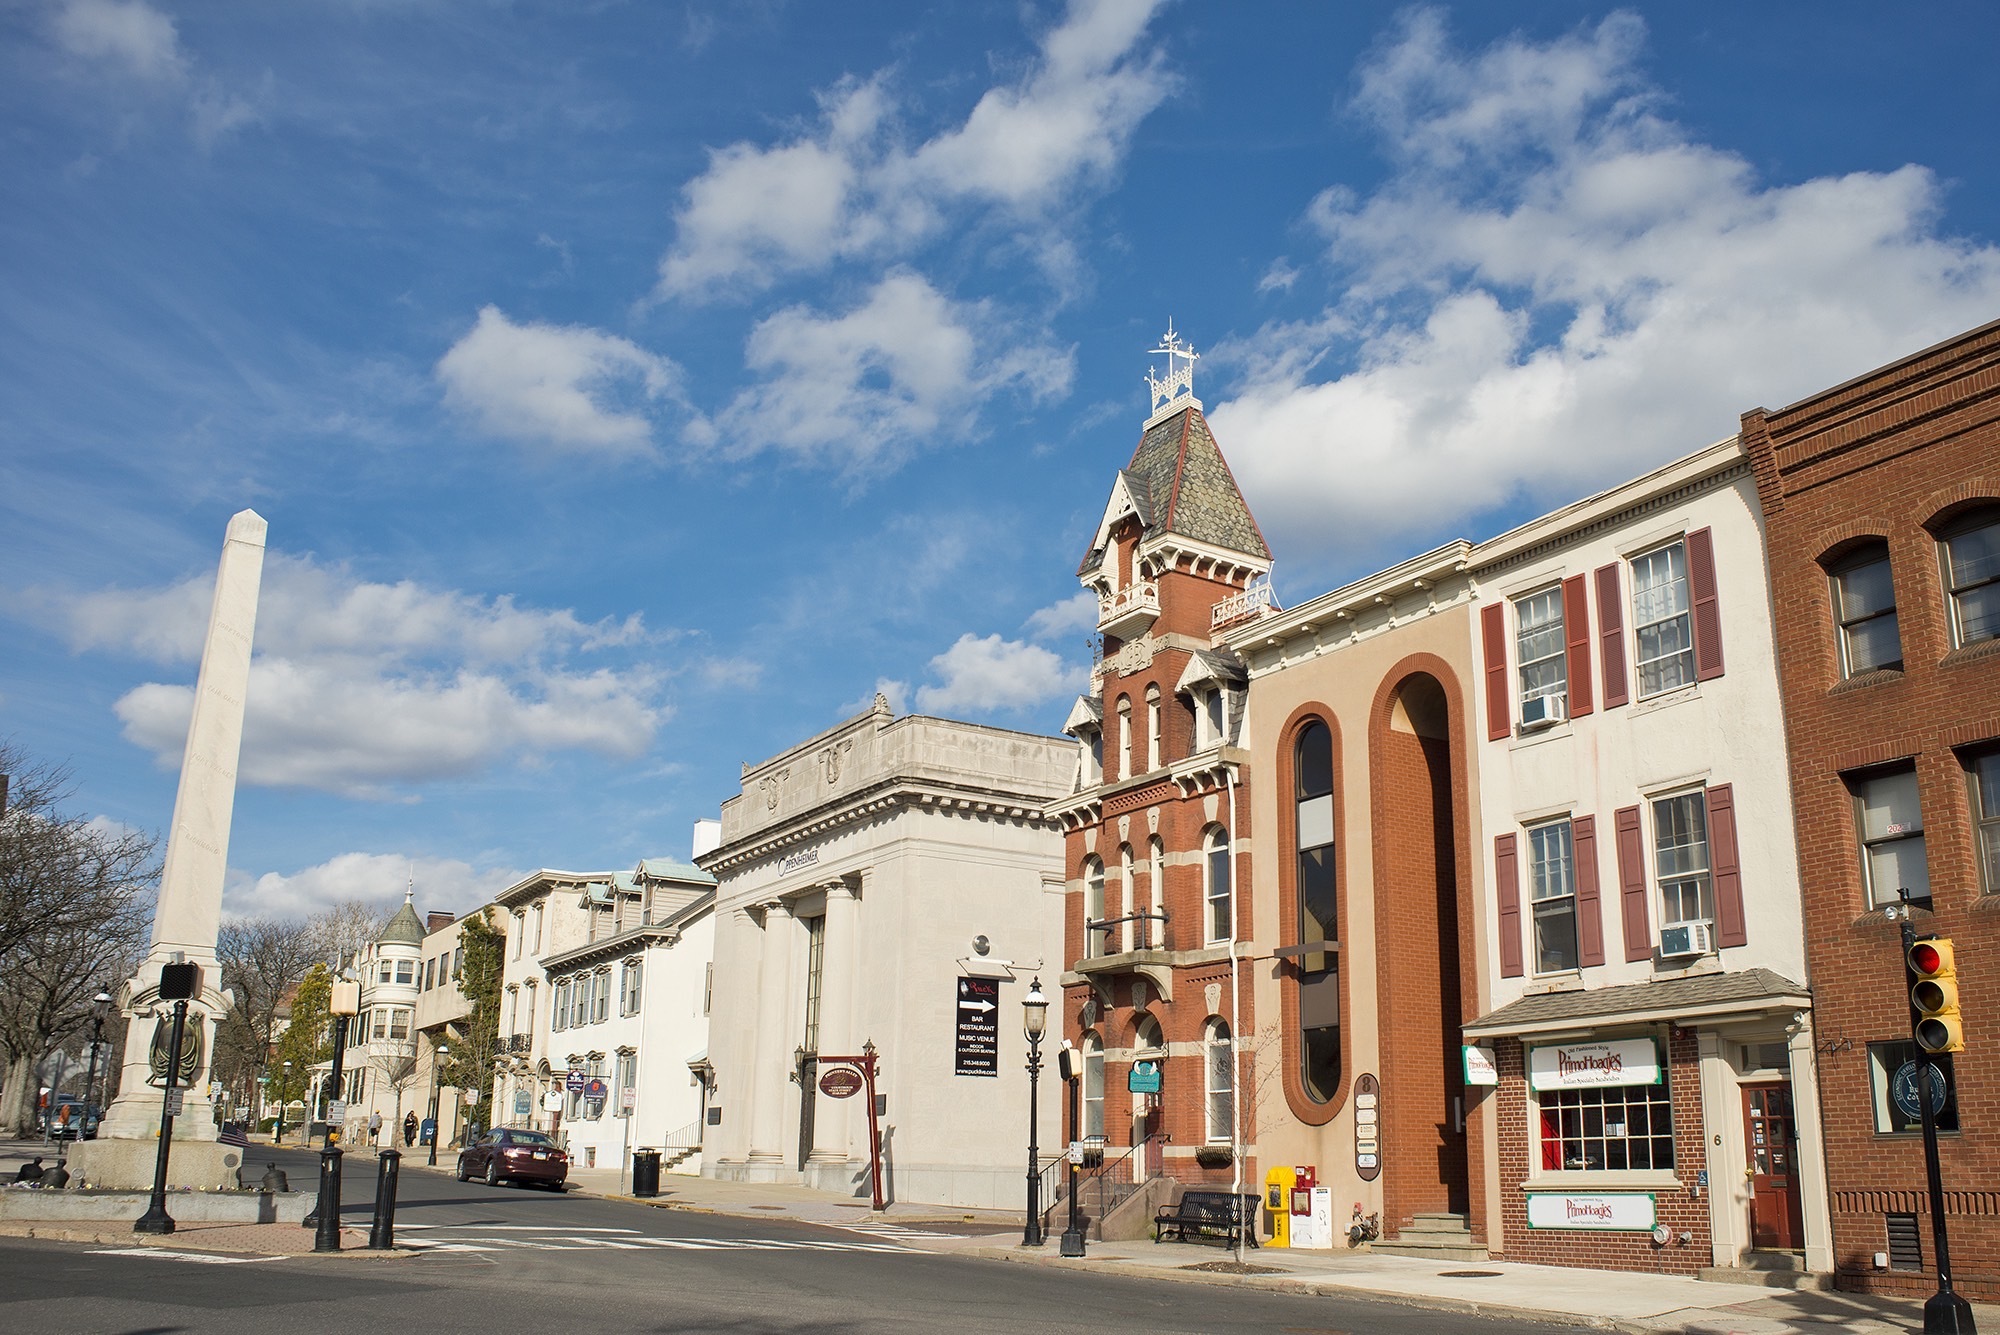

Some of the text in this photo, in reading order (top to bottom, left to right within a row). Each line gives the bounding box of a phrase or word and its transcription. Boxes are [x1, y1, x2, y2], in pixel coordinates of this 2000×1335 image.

[1888, 824, 1902, 834] 202
[959, 1023, 995, 1031] RESTAURANT
[958, 1034, 976, 1042] MUSIC
[1558, 1049, 1622, 1077] PrimoHoagies
[1362, 1076, 1371, 1093] 8
[1714, 1134, 1722, 1146] 6
[1566, 1199, 1612, 1219] PrimoHoagies
